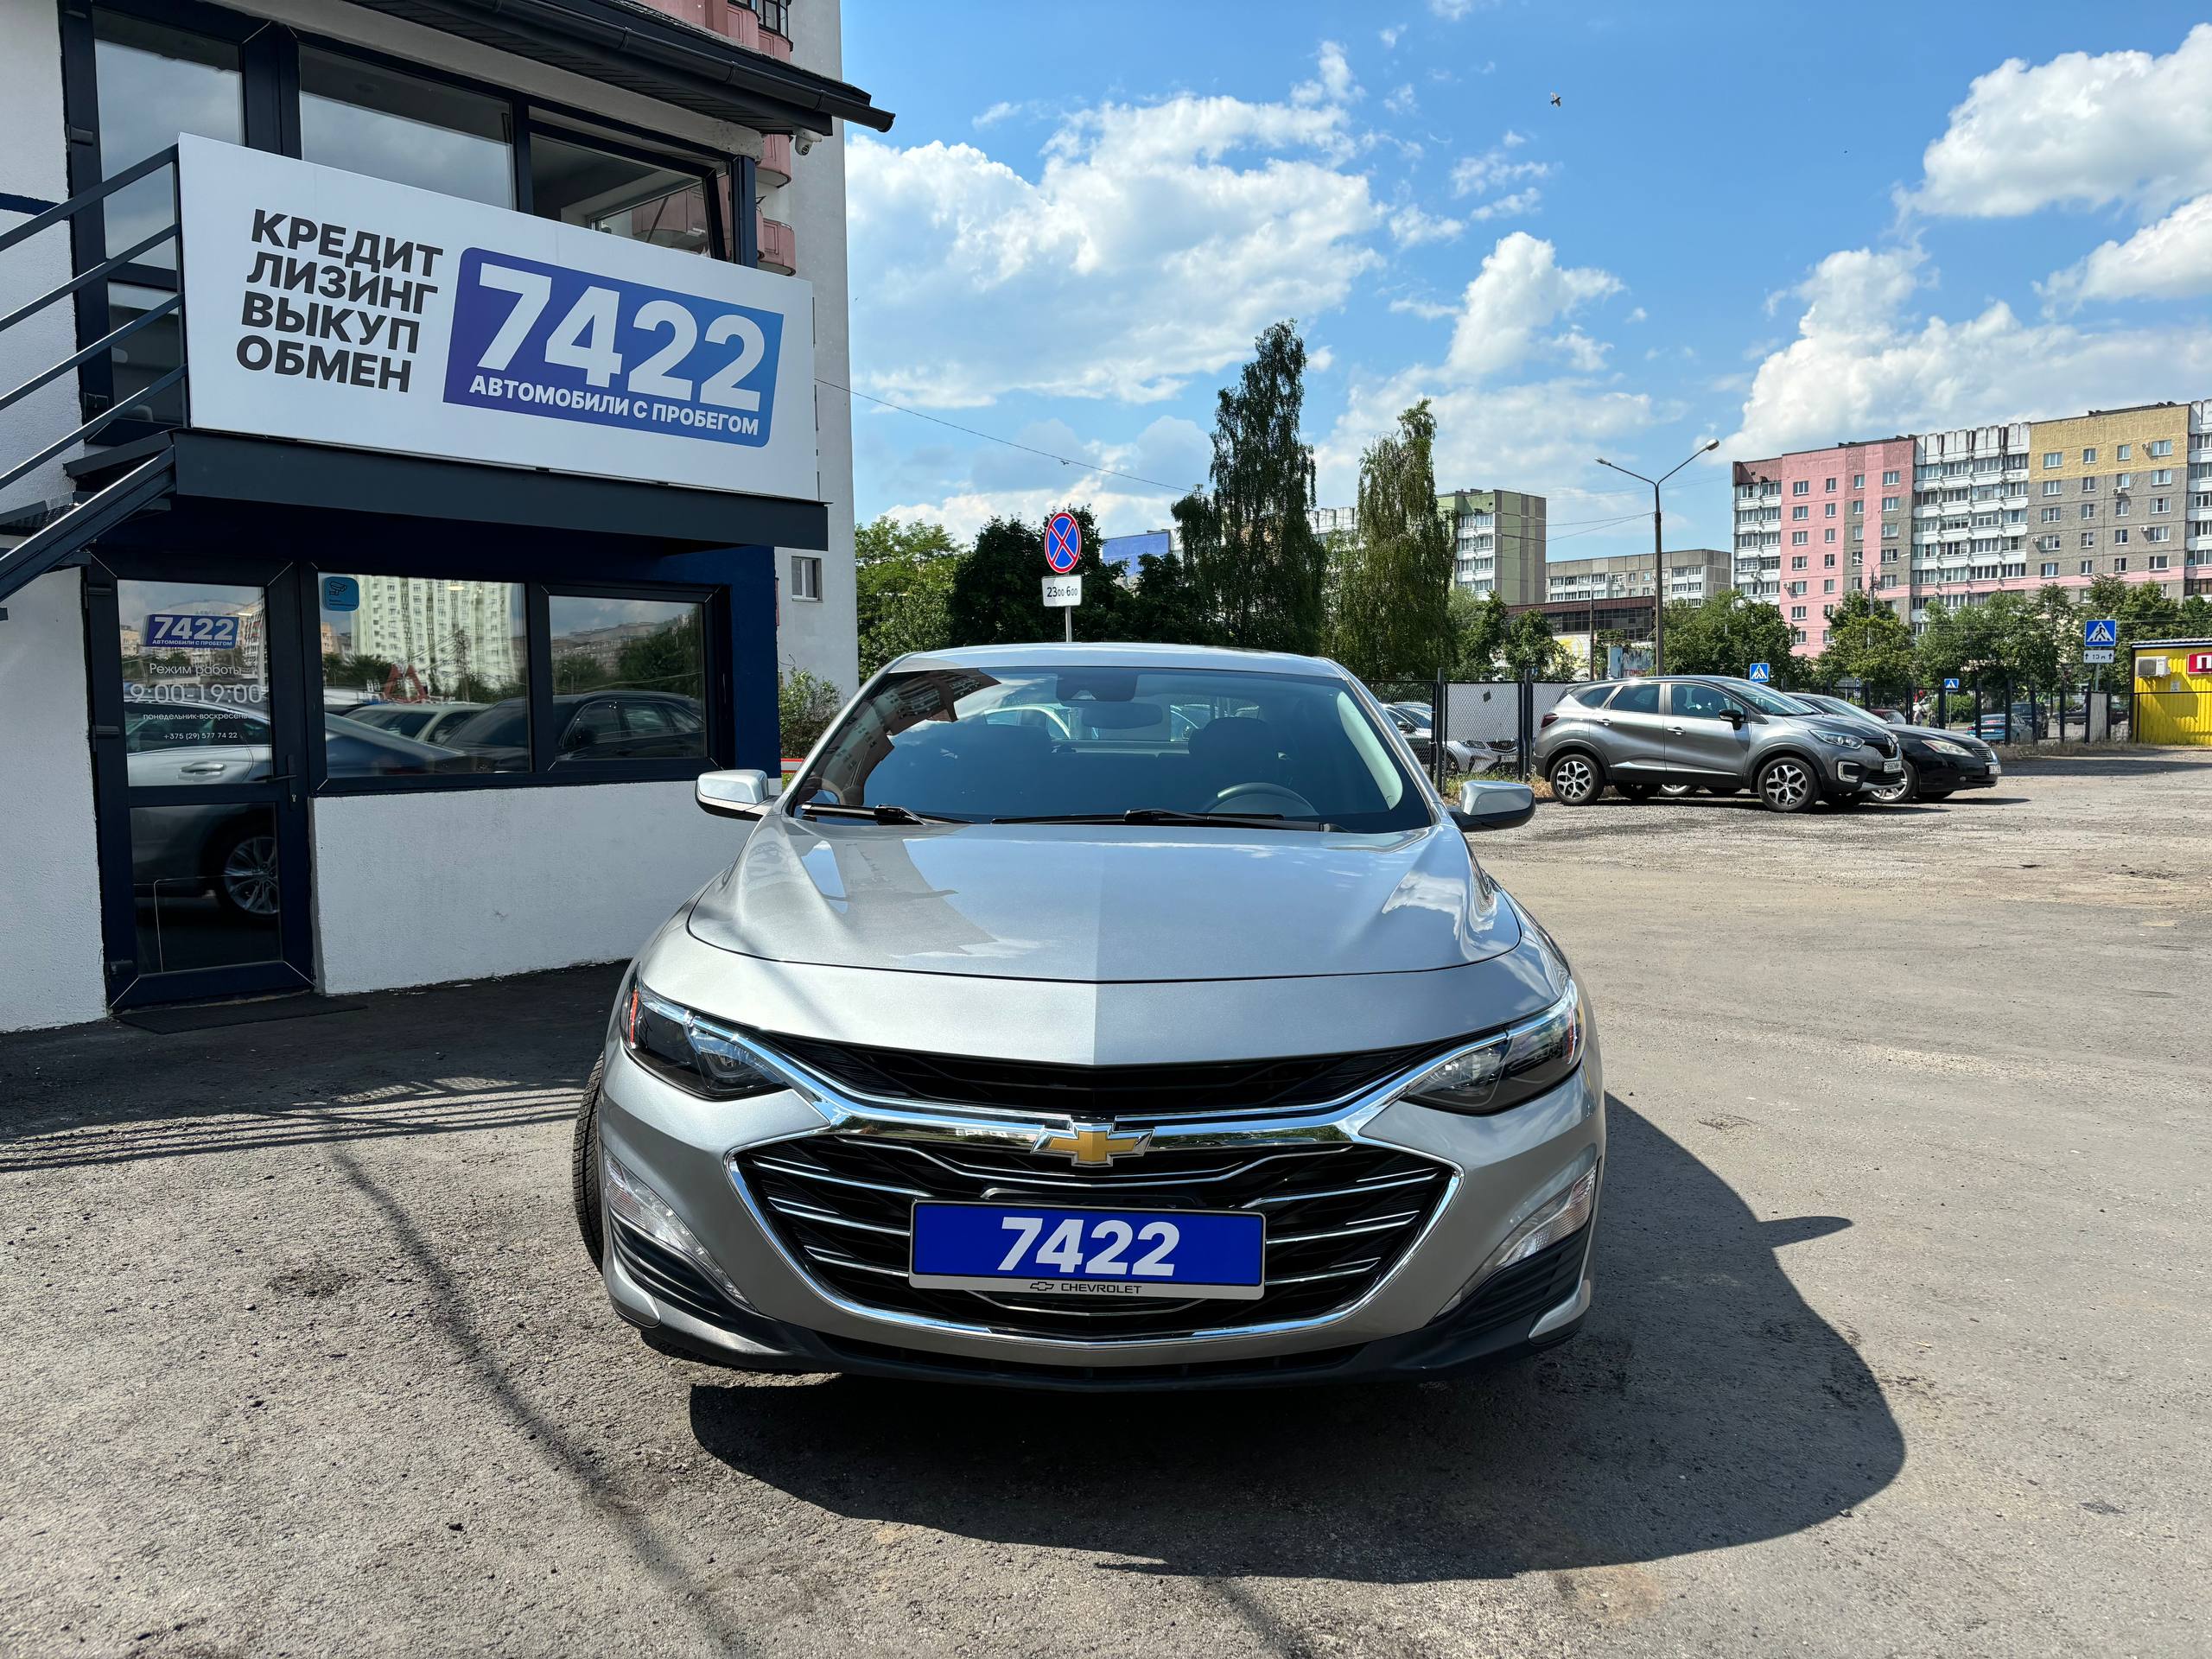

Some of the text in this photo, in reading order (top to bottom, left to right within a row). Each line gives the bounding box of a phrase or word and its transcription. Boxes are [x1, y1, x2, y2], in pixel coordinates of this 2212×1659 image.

[251, 208, 444, 277] КРЕДИТ
[246, 251, 439, 315] ЛИЗИНГ
[241, 290, 420, 354] ВЫКУП
[477, 263, 766, 412] 7422
[236, 334, 412, 393] ОБМЕН
[470, 374, 760, 436] АВТОМОБИЛИ С ПРОБЕГОМ
[154, 616, 234, 640] 7422
[130, 684, 262, 703] 9:00-19:00
[149, 662, 242, 677] Режим работы
[997, 1217, 1180, 1276] 7422
[1061, 1282, 1142, 1294] CHEVROLET
